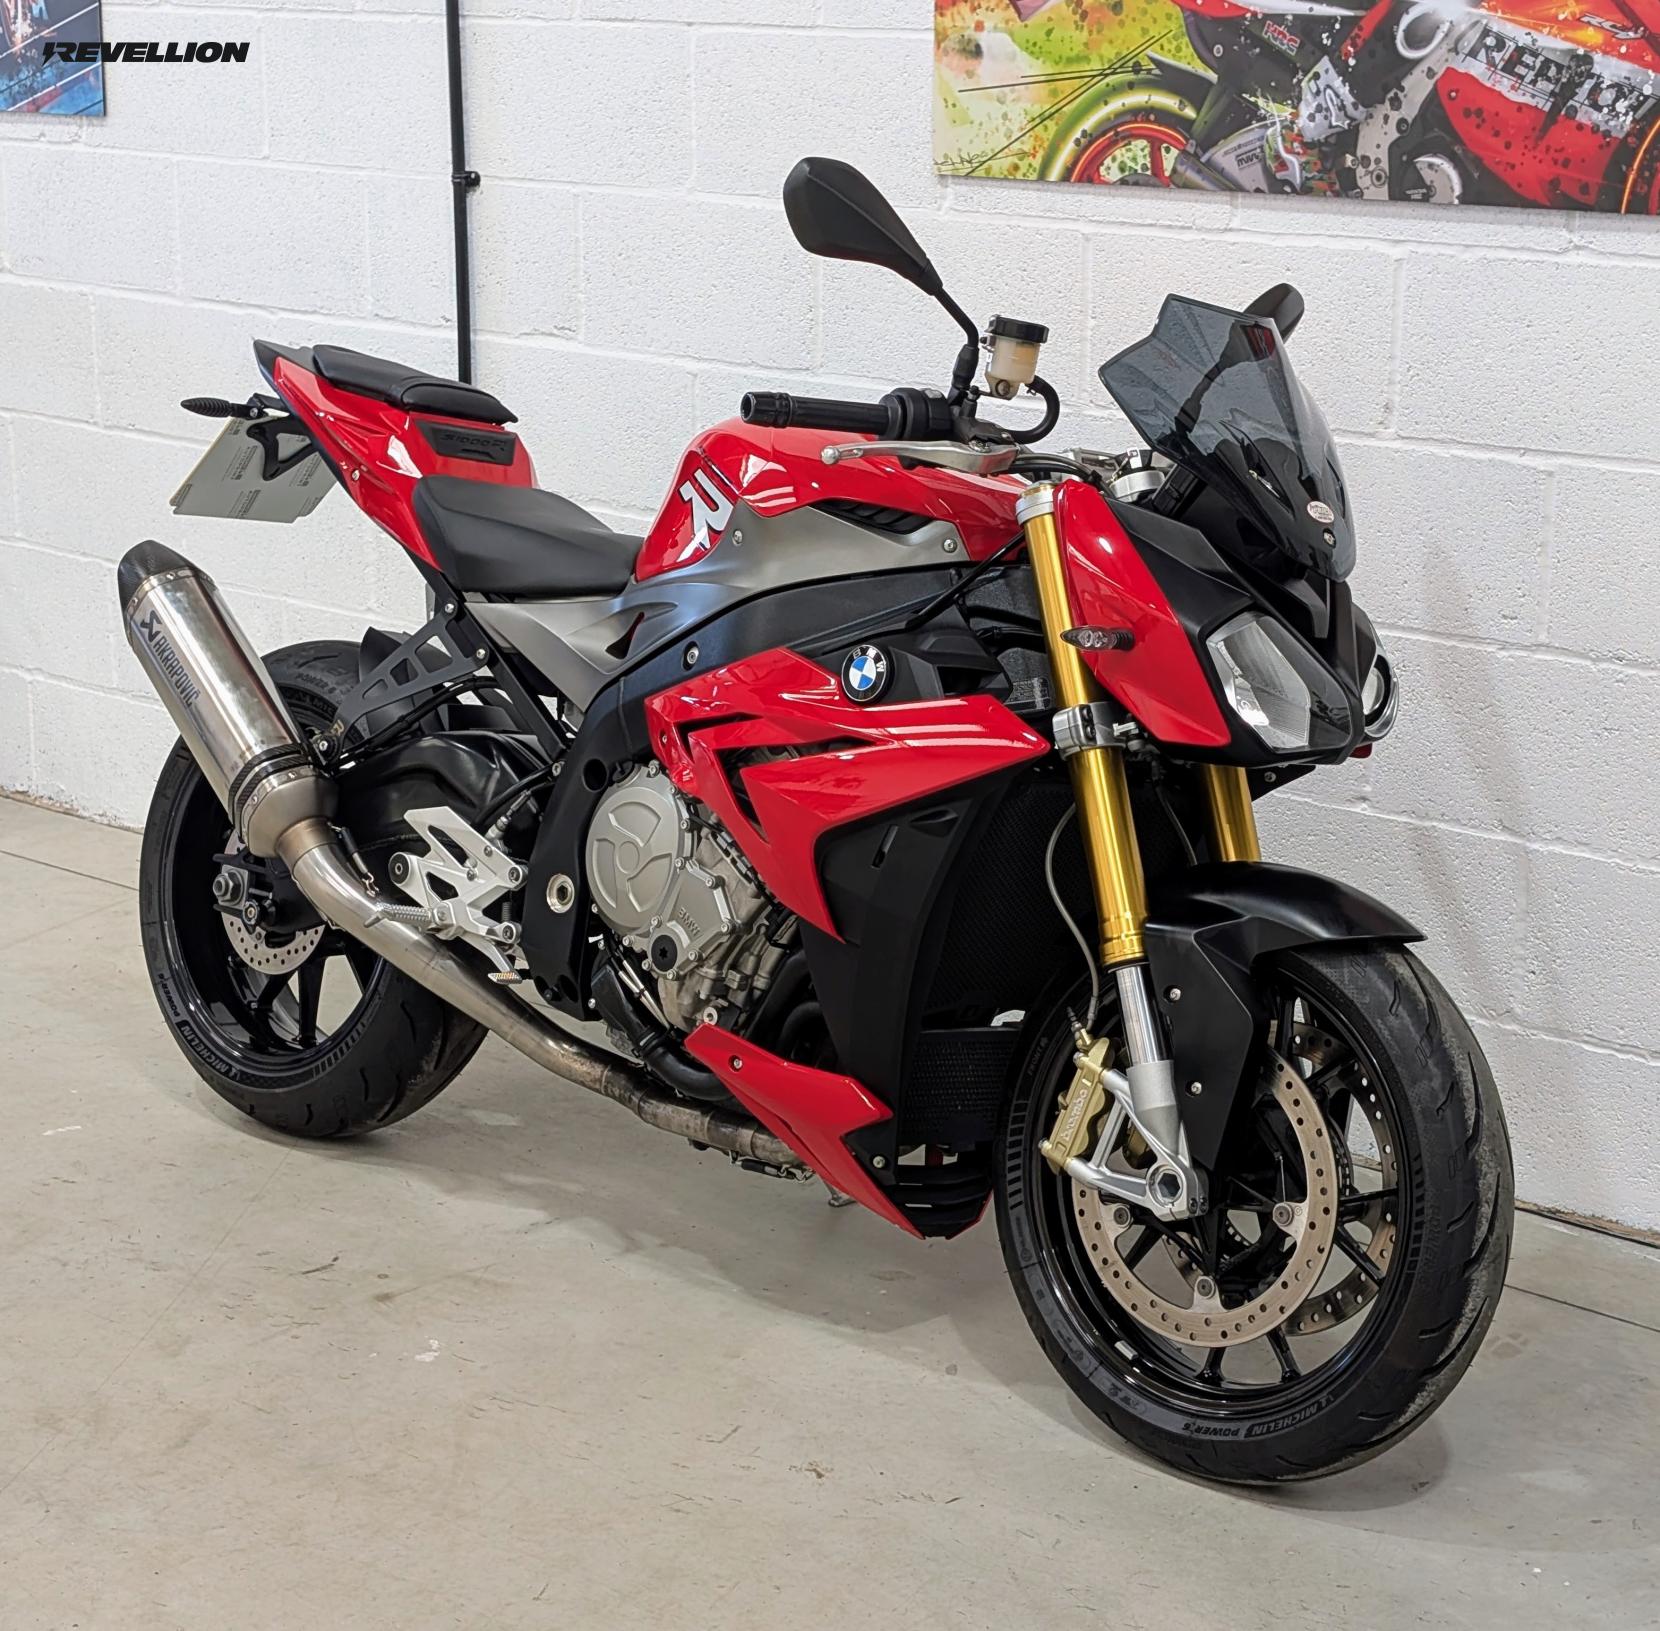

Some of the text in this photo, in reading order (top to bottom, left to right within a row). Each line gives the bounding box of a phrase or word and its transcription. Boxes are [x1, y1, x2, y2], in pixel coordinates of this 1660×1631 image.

[852, 647, 886, 673] BMW
[678, 906, 703, 940] BMW
[181, 1025, 229, 1072] MICHELIN
[1060, 1089, 1089, 1142] brembo
[1195, 1425, 1241, 1438] POWER
[1252, 1403, 1319, 1435] MICHELIN
